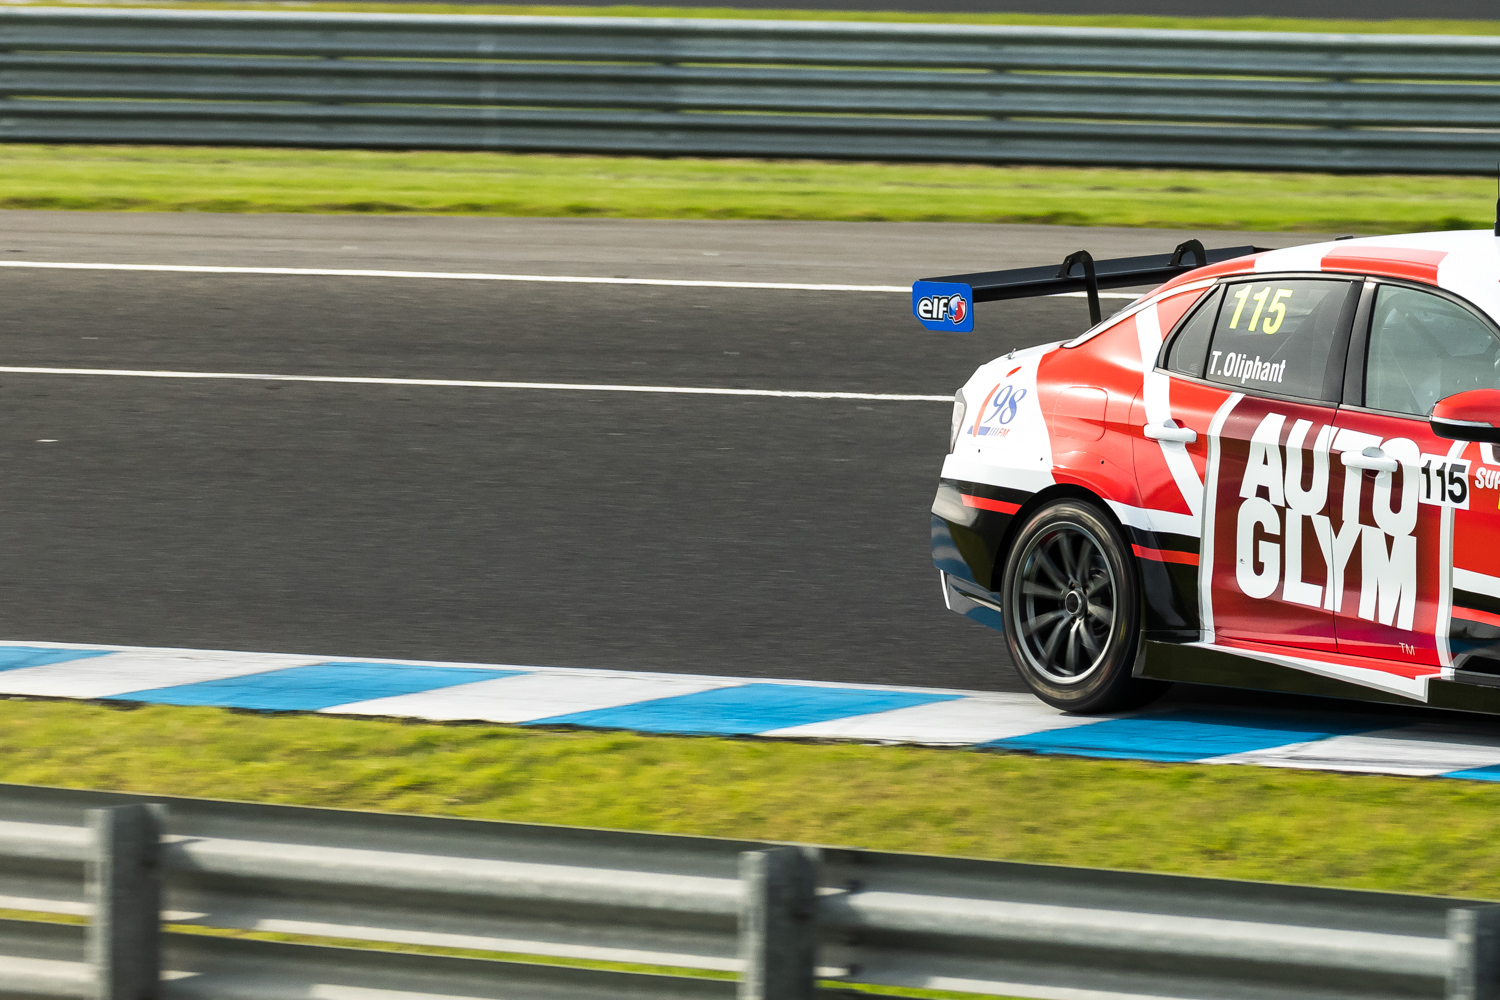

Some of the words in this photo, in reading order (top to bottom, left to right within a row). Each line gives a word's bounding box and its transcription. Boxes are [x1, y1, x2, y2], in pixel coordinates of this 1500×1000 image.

[918, 295, 948, 320] elf
[1229, 284, 1293, 334] 115
[1239, 412, 1420, 537] AUTO
[1421, 459, 1467, 504] 115
[1236, 496, 1417, 631] GLYM
